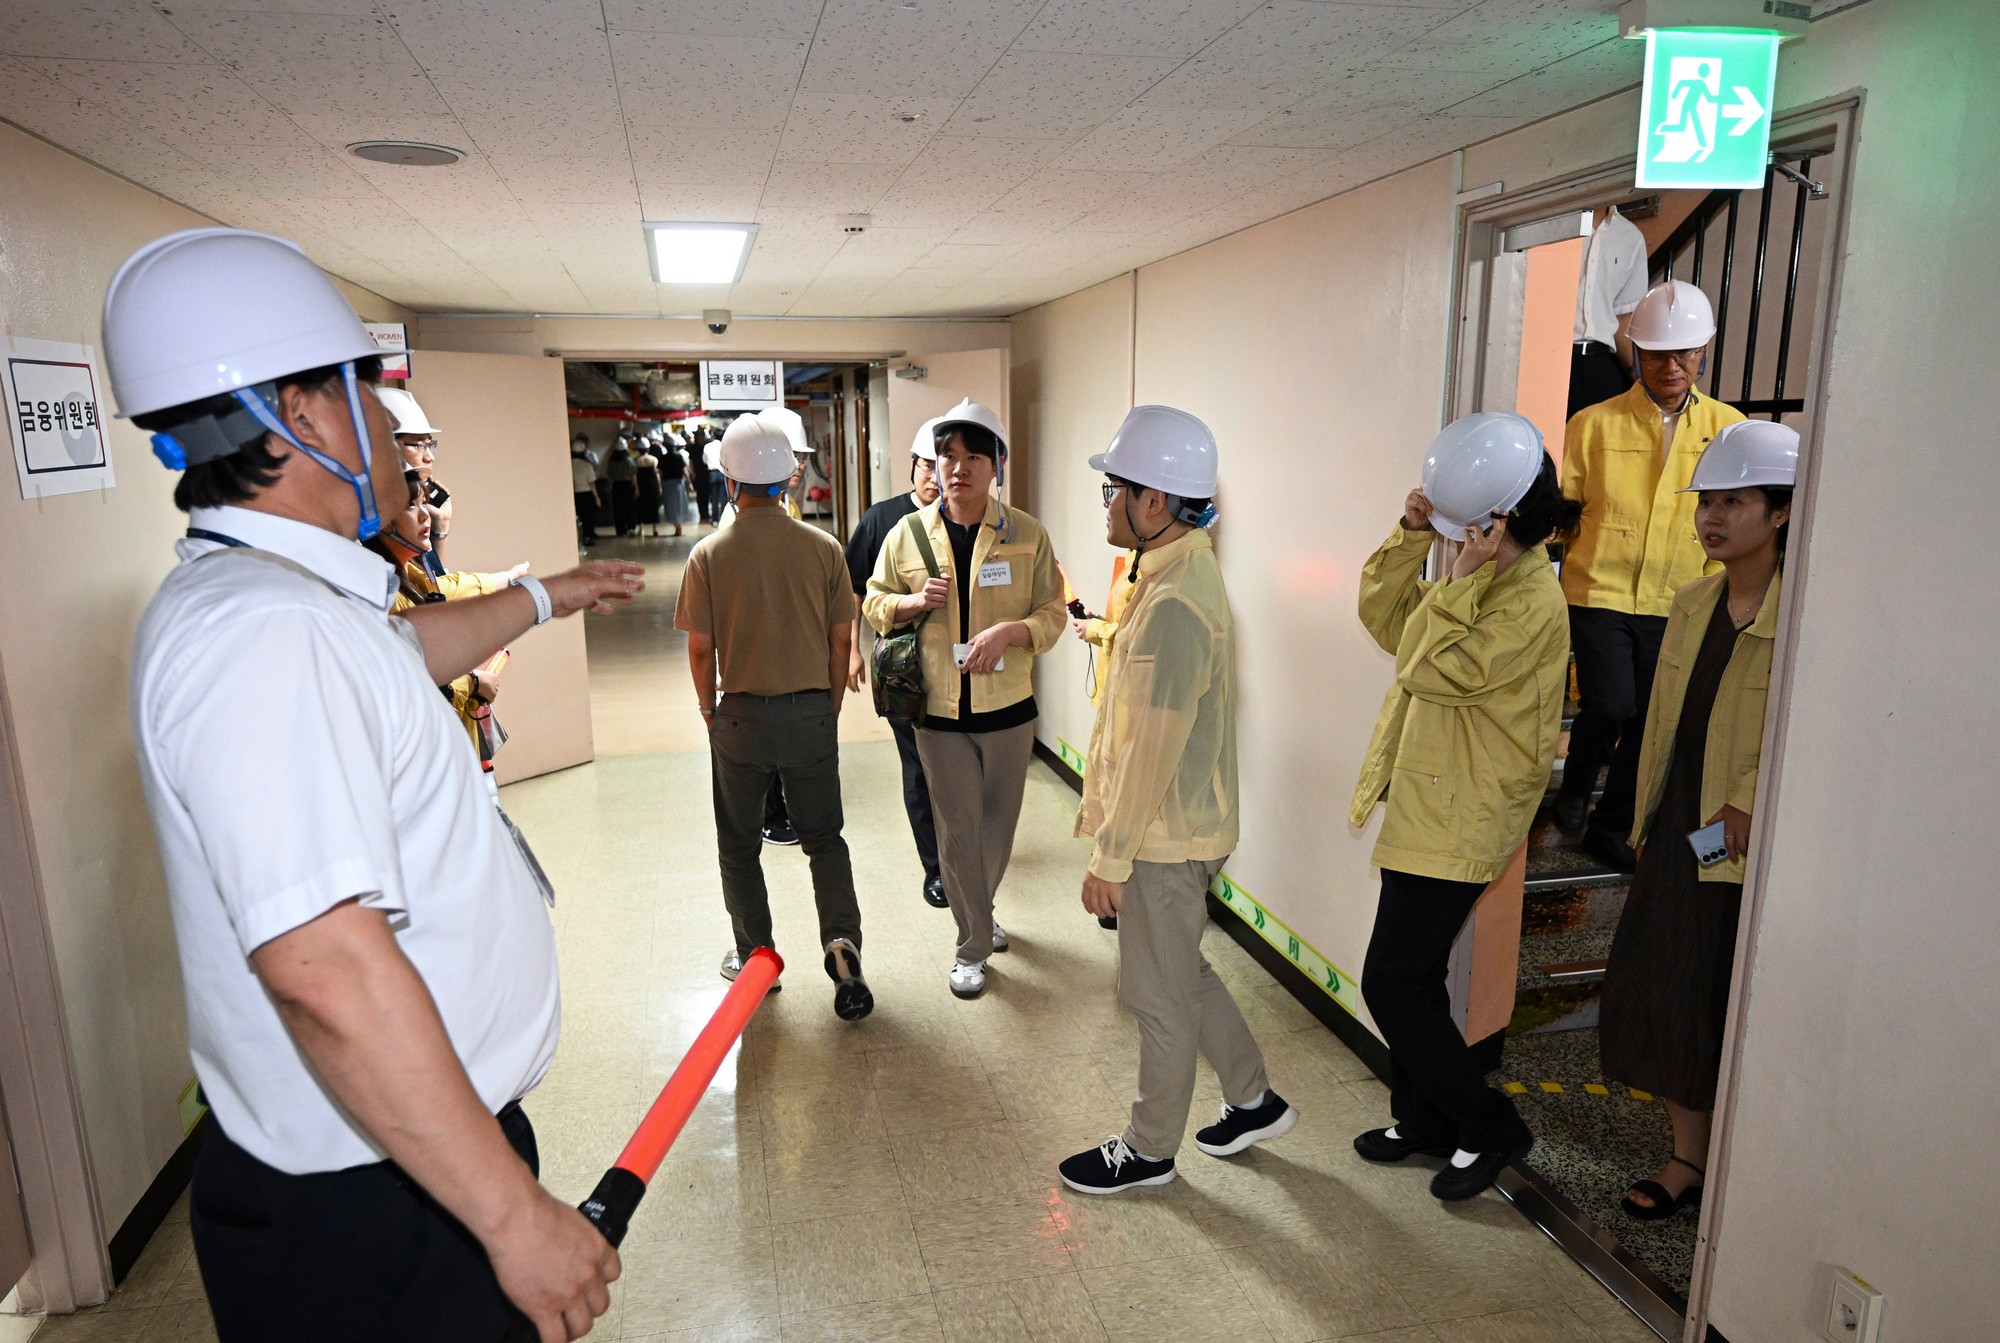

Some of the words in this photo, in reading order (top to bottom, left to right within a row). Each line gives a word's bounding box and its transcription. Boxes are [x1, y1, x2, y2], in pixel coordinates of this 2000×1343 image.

[377, 333, 403, 341] WOMEN
[709, 373, 775, 386] 금융위원회
[19, 401, 99, 432] 금융위원회
